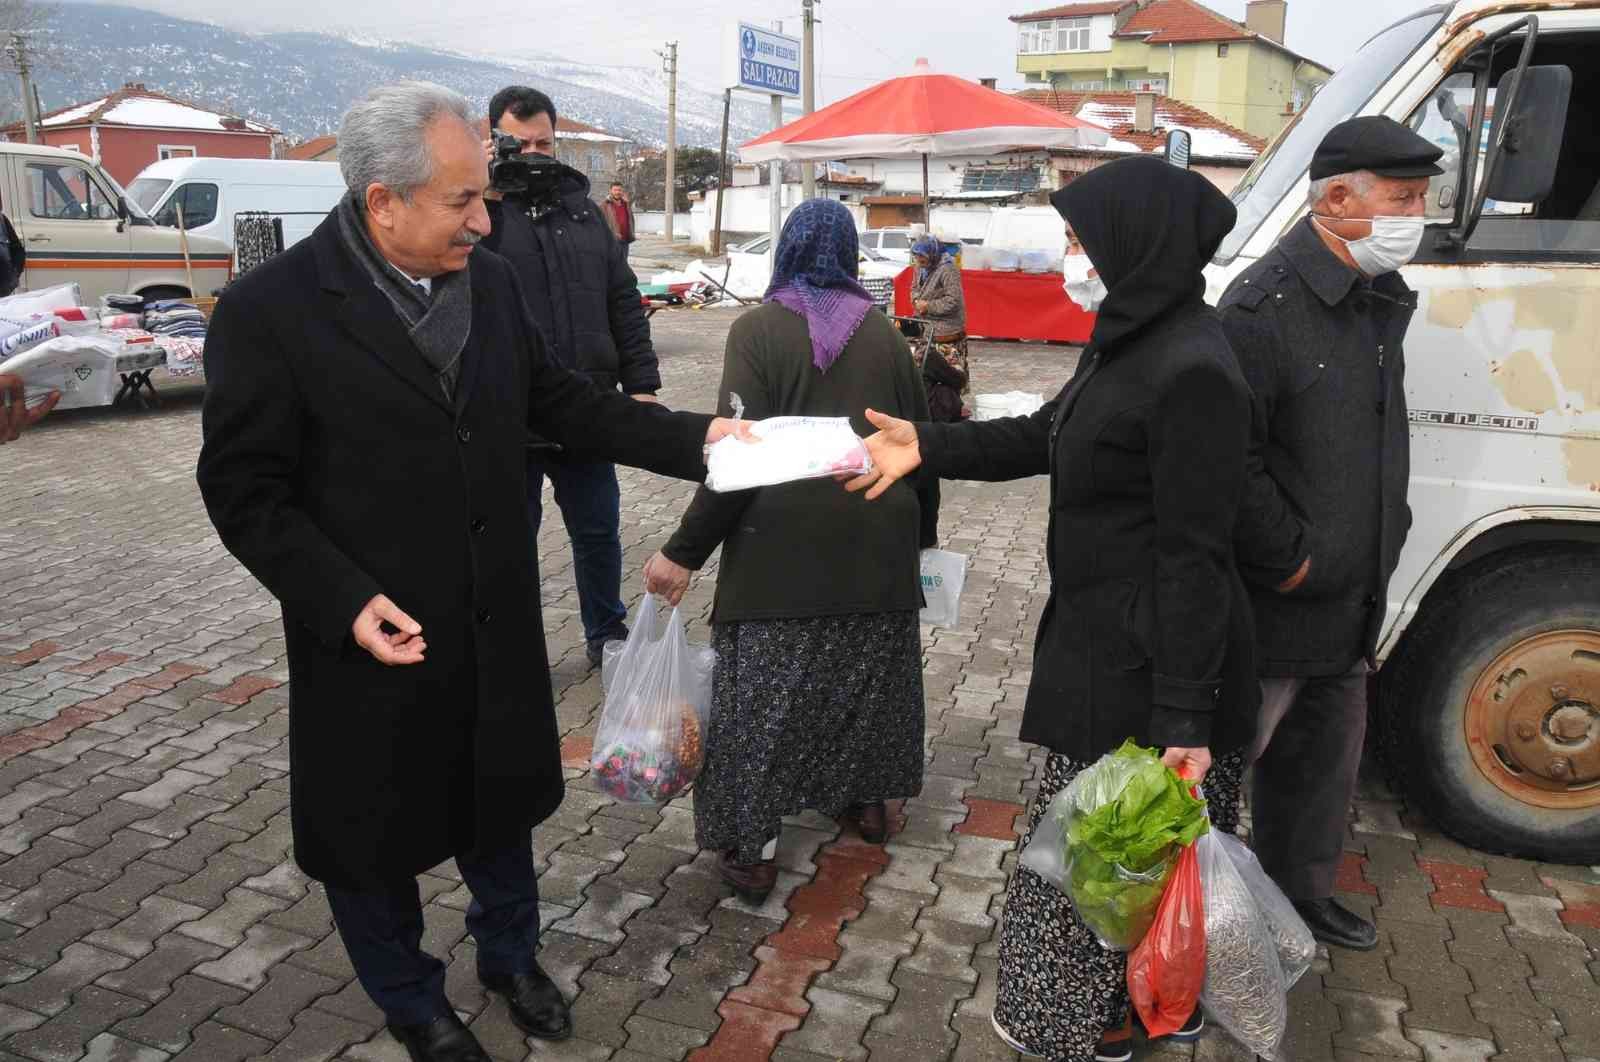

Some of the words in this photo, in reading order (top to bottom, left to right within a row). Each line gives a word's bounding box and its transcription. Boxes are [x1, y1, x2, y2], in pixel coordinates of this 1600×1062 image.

[743, 62, 764, 82] SALI
[766, 65, 797, 90] PAZARI
[1453, 412, 1539, 430] INJECTION
